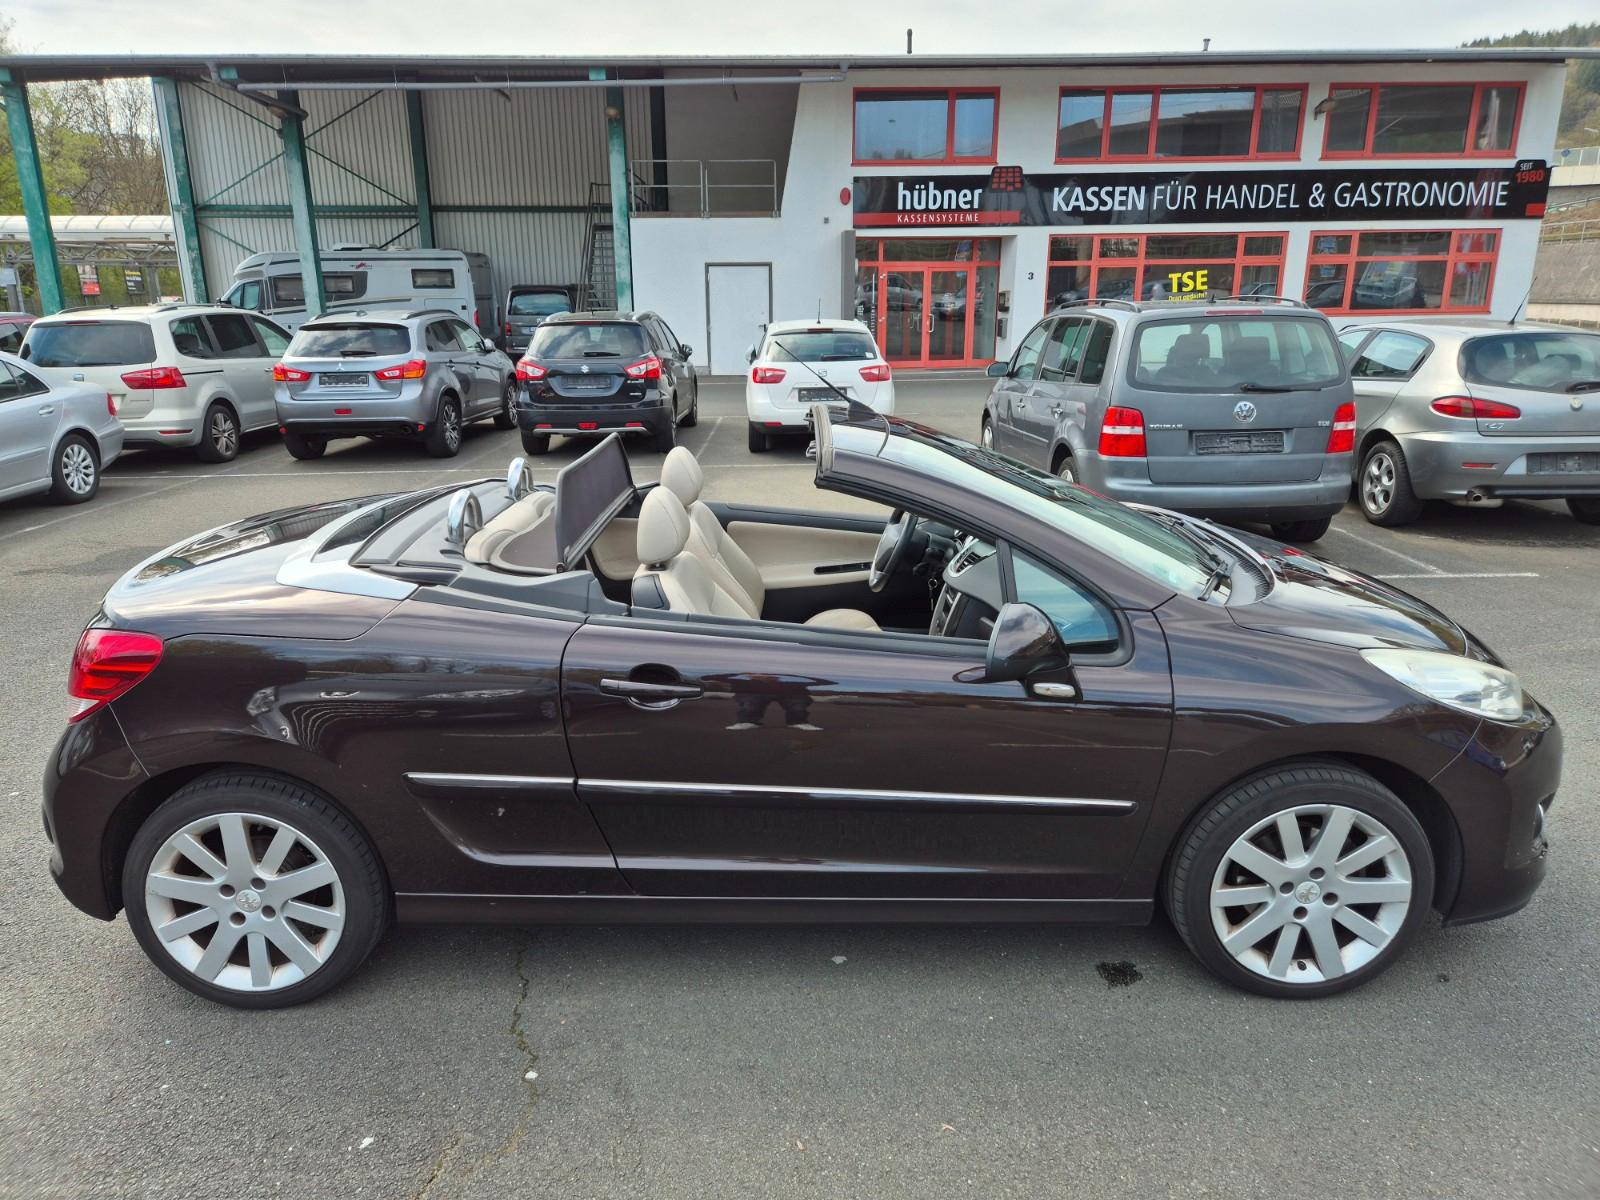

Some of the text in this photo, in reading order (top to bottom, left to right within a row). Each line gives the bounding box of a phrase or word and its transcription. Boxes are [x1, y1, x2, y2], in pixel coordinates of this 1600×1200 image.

[1519, 162, 1534, 171] SEIT
[1515, 170, 1544, 184] 1980
[897, 182, 983, 211] hübner
[1052, 181, 1510, 212] KASSEN FÜR HANDEL & GASTRONOMIE
[897, 212, 980, 224] KASSENSYSTEME
[1027, 272, 1035, 281] 3
[1168, 269, 1208, 293] TSE
